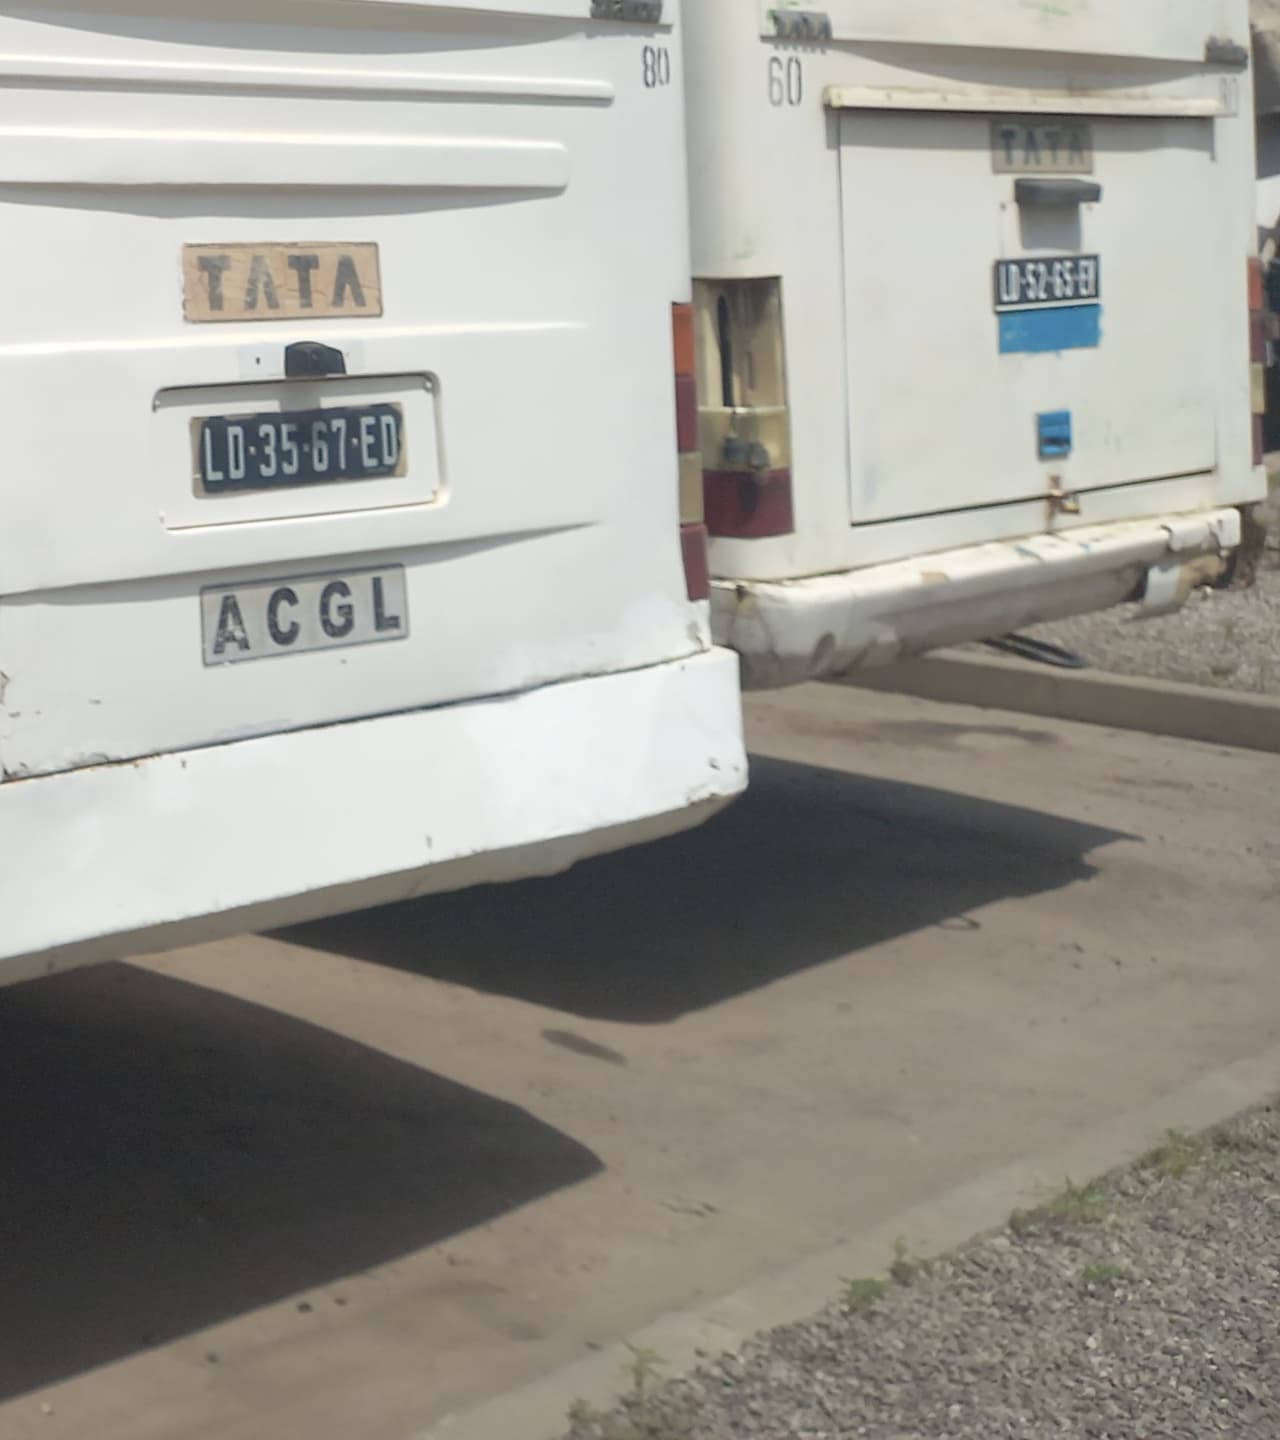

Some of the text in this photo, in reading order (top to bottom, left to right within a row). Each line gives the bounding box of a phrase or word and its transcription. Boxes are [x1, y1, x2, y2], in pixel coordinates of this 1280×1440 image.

[768, 56, 803, 106] 60
[999, 129, 1087, 166] TATA
[196, 254, 368, 312] TATA
